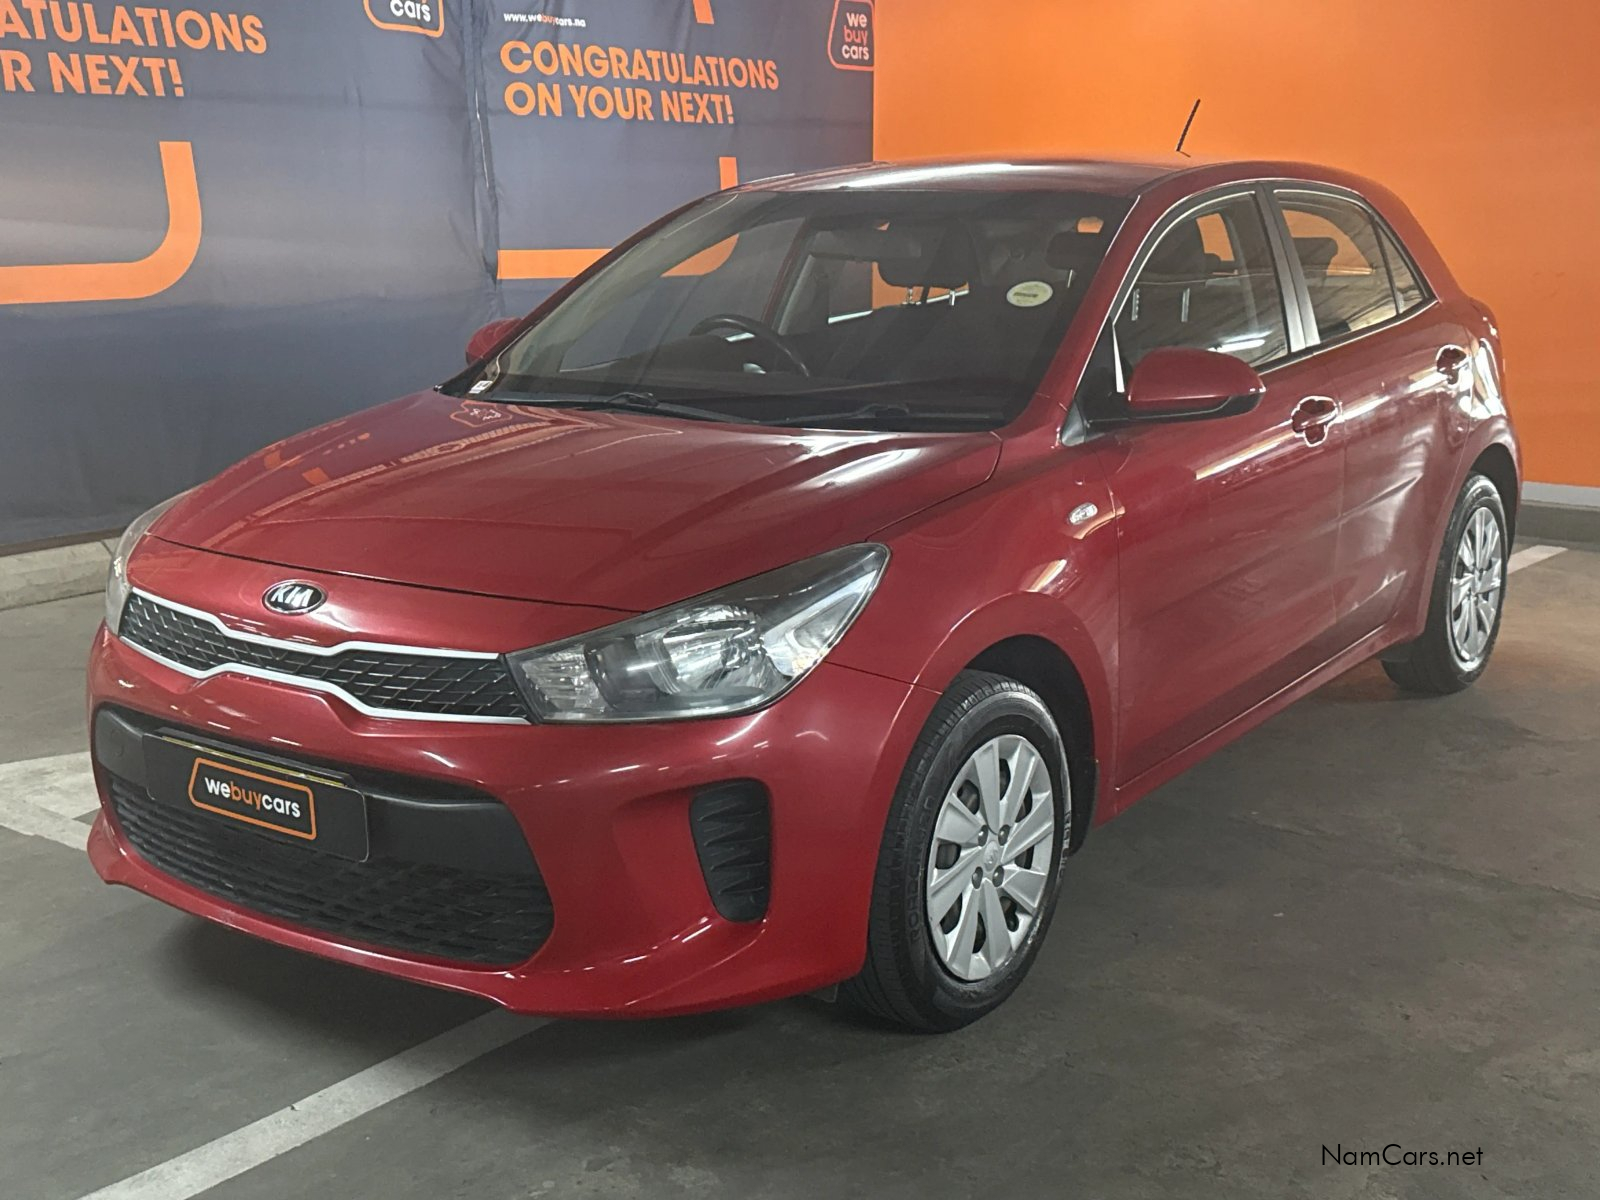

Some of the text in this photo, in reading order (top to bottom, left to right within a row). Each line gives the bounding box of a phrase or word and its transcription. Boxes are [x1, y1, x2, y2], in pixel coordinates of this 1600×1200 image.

[390, 0, 431, 22] cars
[846, 12, 868, 28] we
[843, 25, 868, 46] buy
[842, 44, 870, 60] cars
[0, 49, 184, 97] R NEXT!
[500, 40, 779, 90] CONGRATULATIONS
[504, 82, 735, 124] ON YOUR NEXT!
[270, 584, 315, 607] KIA
[204, 776, 301, 818] webuycars
